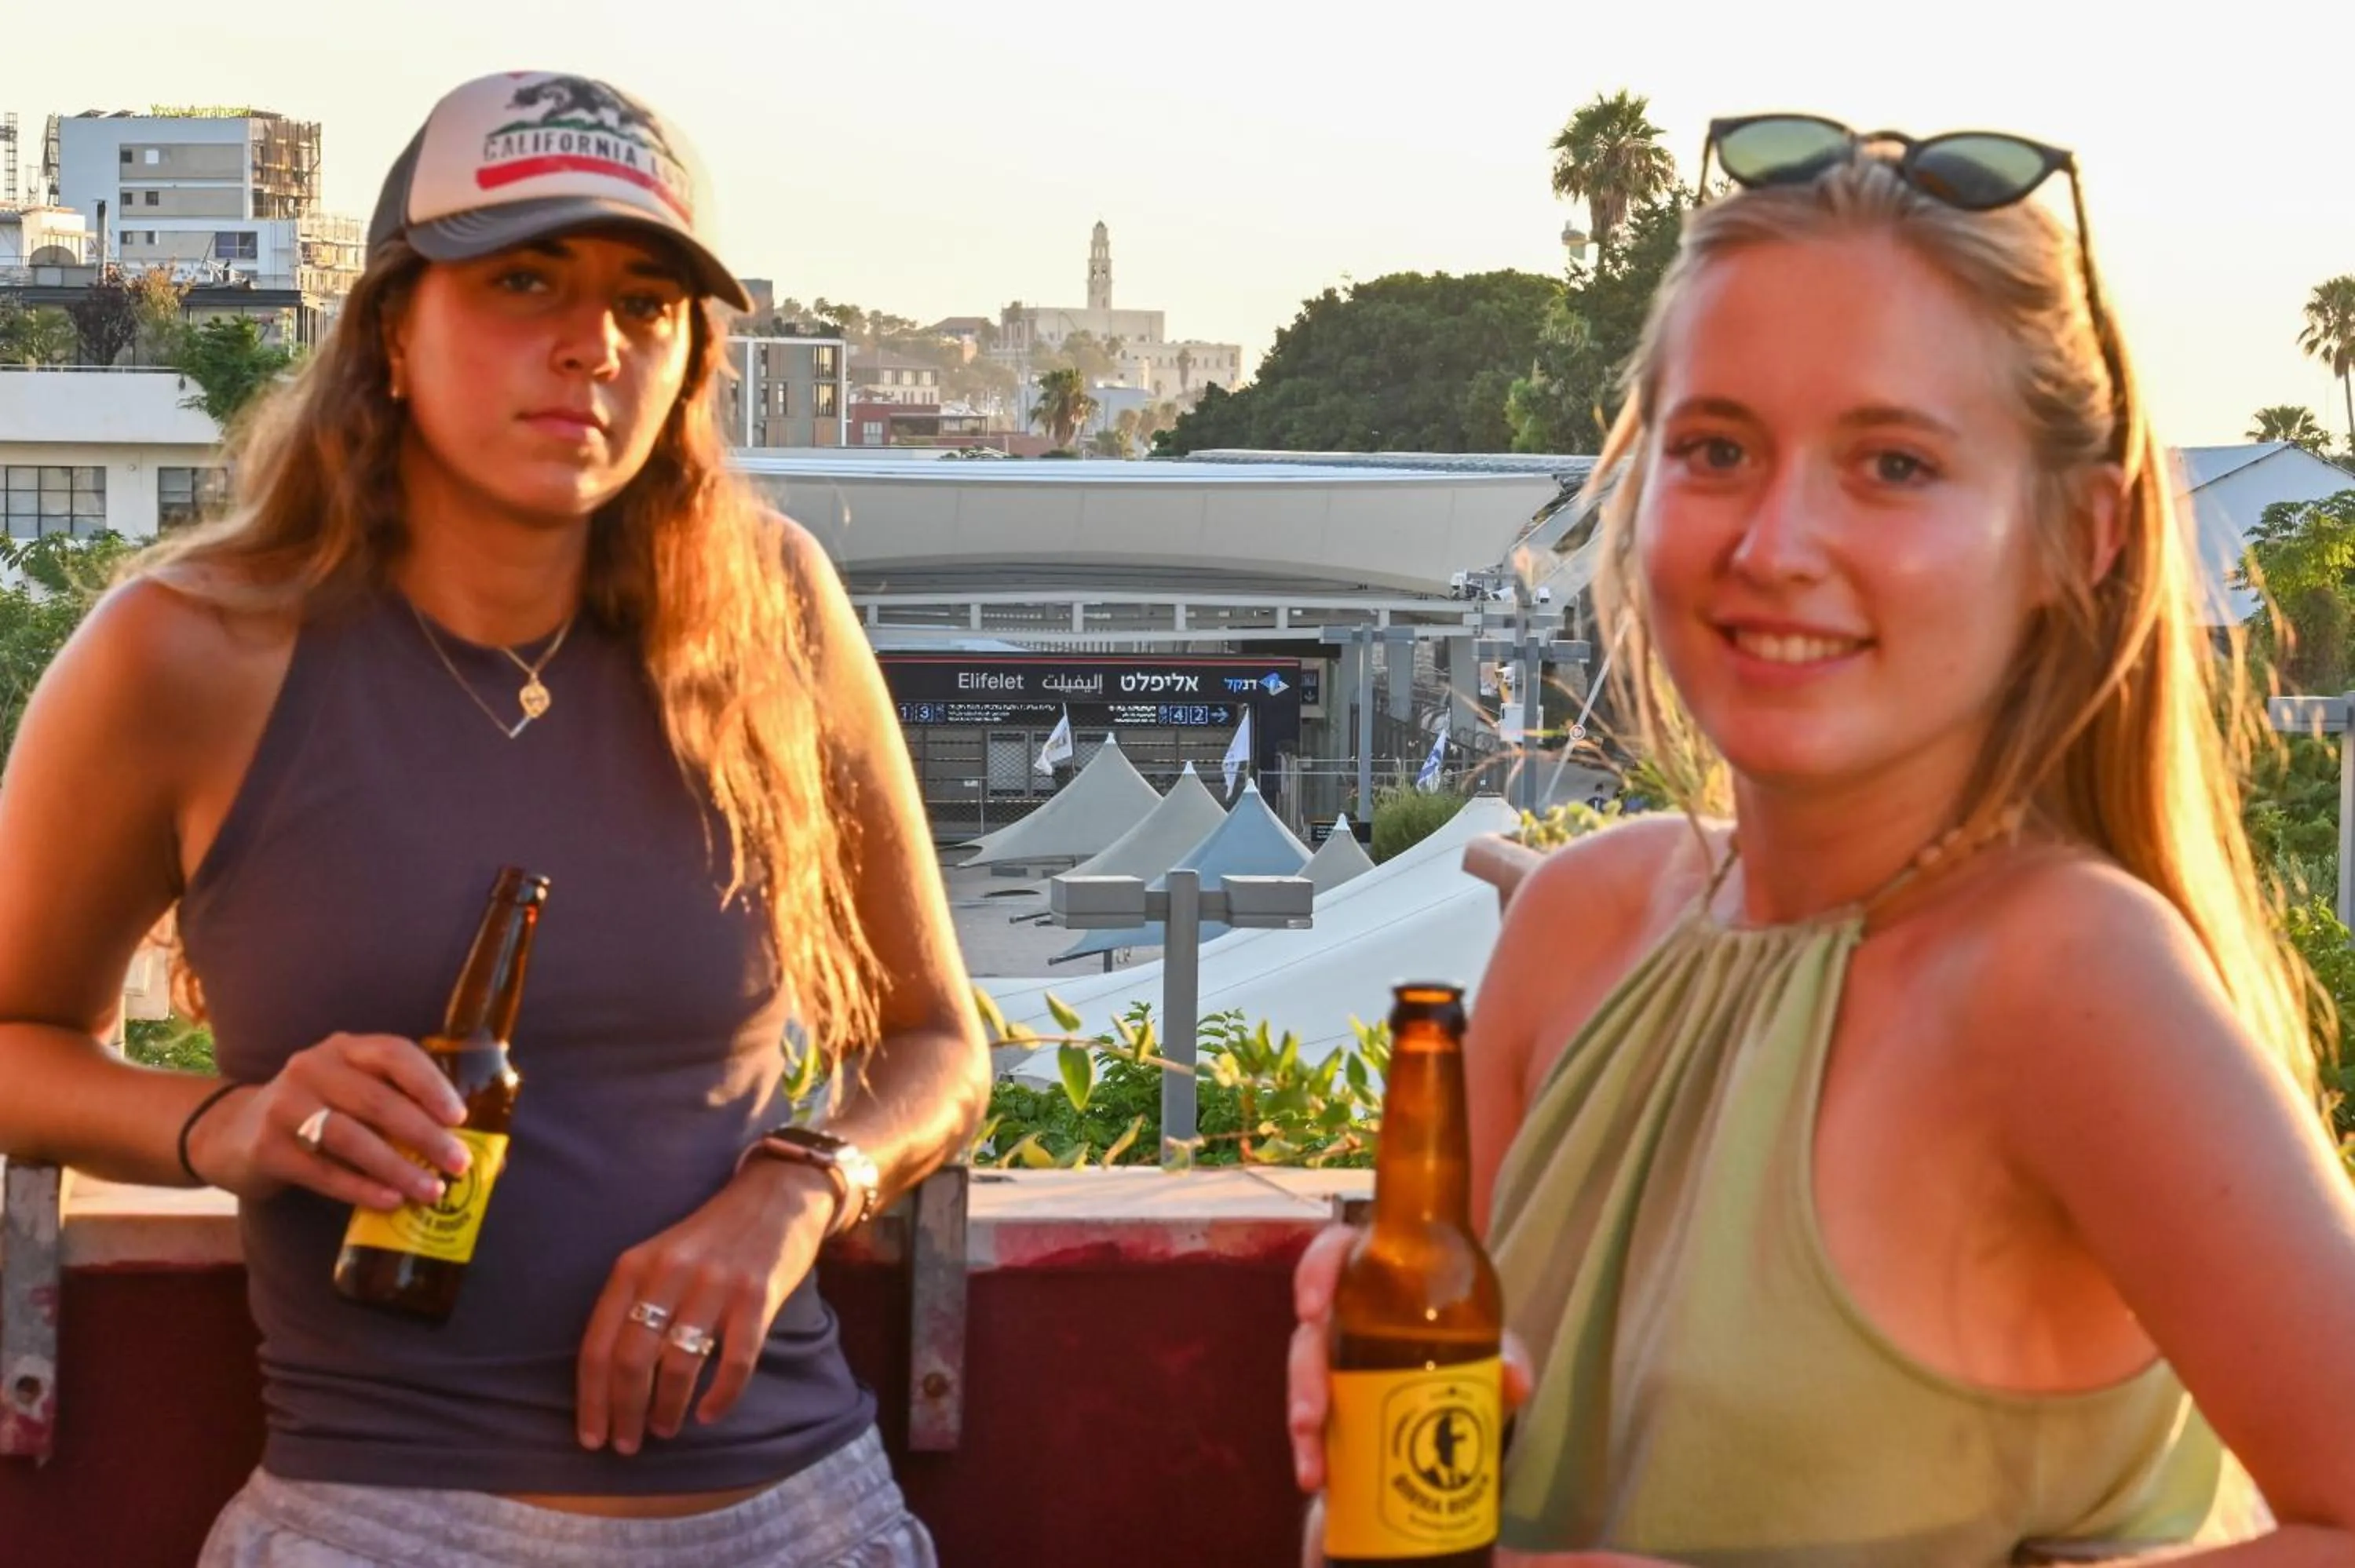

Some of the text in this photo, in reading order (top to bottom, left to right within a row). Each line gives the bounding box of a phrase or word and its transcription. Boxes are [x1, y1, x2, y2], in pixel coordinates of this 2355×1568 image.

[484, 132, 637, 166] CALIFORNIA
[958, 673, 1024, 689] Elifelet
[1120, 672, 1199, 691] אליפלט
[1224, 677, 1257, 694] דנקל
[919, 706, 929, 719] 3
[1174, 709, 1204, 721] 4 2
